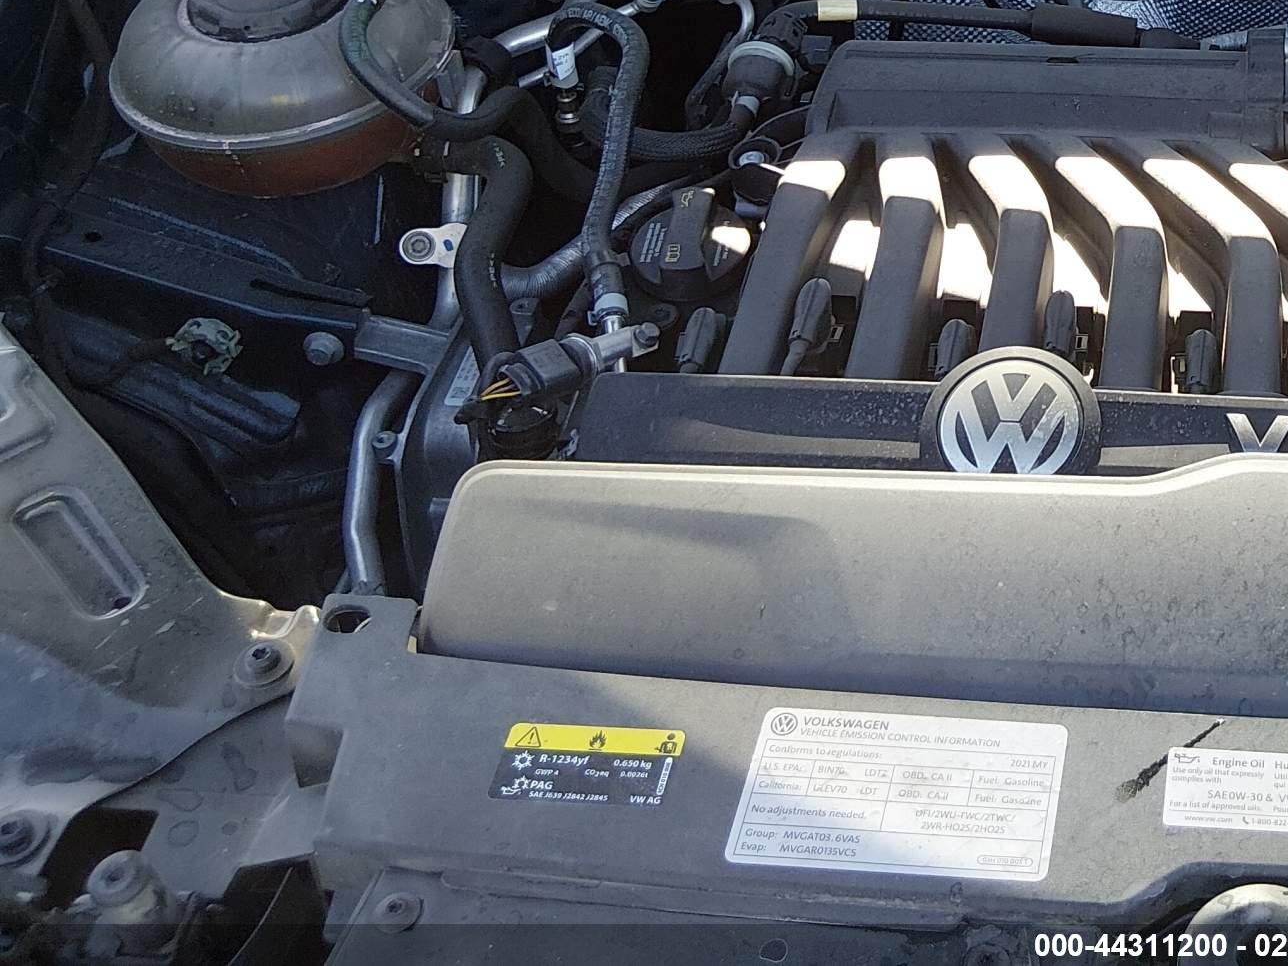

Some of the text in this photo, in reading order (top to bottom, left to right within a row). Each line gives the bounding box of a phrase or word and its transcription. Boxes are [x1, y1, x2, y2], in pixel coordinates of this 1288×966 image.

[803, 716, 890, 731] VOLKSWAGEN
[801, 728, 1001, 747] VEHICLE EMISSION CONTROL INFORMATION
[769, 745, 812, 754] Conforms
[816, 747, 825, 755] to
[539, 754, 653, 770] R-1234yf 0.650 kg
[1010, 759, 1032, 768] 2021
[1212, 757, 1248, 768] Engine
[1250, 759, 1265, 768] Oil
[930, 772, 946, 781] CA
[530, 780, 554, 790] PAG
[528, 791, 544, 799] SAE
[629, 795, 646, 804] VW
[647, 795, 663, 805] AG
[1265, 792, 1273, 802] &
[751, 804, 766, 814] No
[767, 805, 827, 817] adjustments
[745, 828, 777, 840] Group:
[740, 841, 767, 853] Evap:
